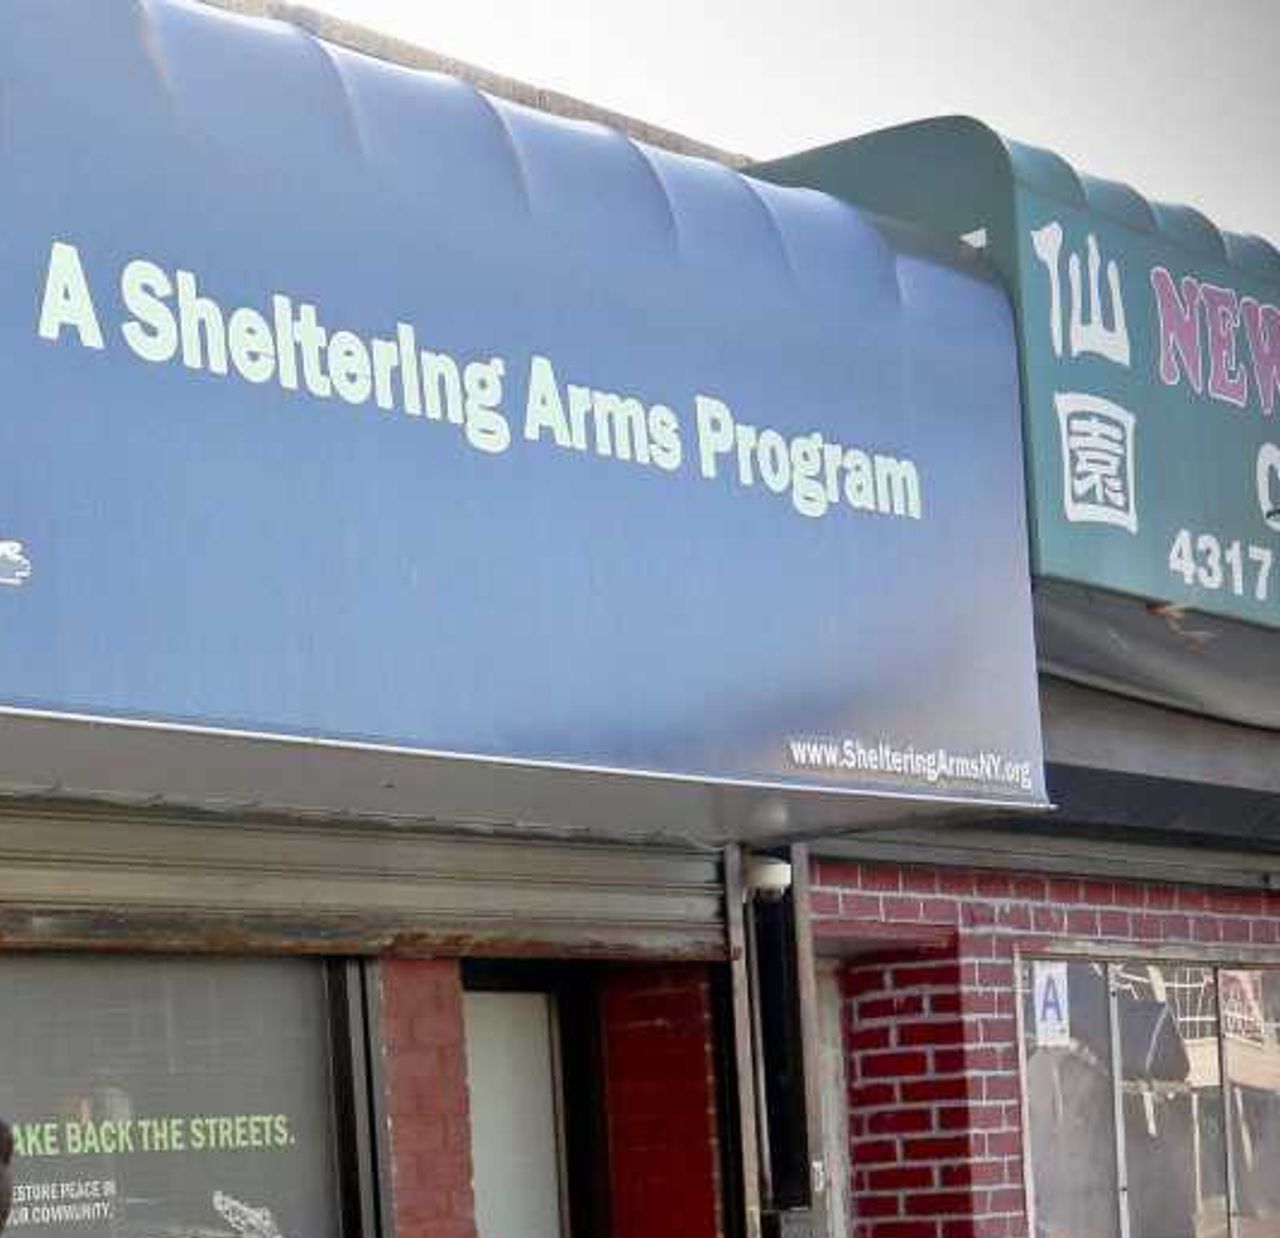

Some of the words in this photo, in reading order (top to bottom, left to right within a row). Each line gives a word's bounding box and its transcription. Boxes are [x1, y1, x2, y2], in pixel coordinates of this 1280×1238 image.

[38, 241, 105, 349] A
[121, 258, 511, 454] Sheltering
[523, 355, 683, 473] Arms
[695, 395, 923, 519] Program
[1169, 528, 1273, 601] 4317
[790, 738, 1033, 789] www.ShelteringArmsNY.org
[1041, 975, 1064, 1021] A
[12, 1122, 60, 1156] AKE
[66, 1119, 134, 1154] BACK
[138, 1117, 185, 1151] THE
[190, 1114, 296, 1148] STREETS.
